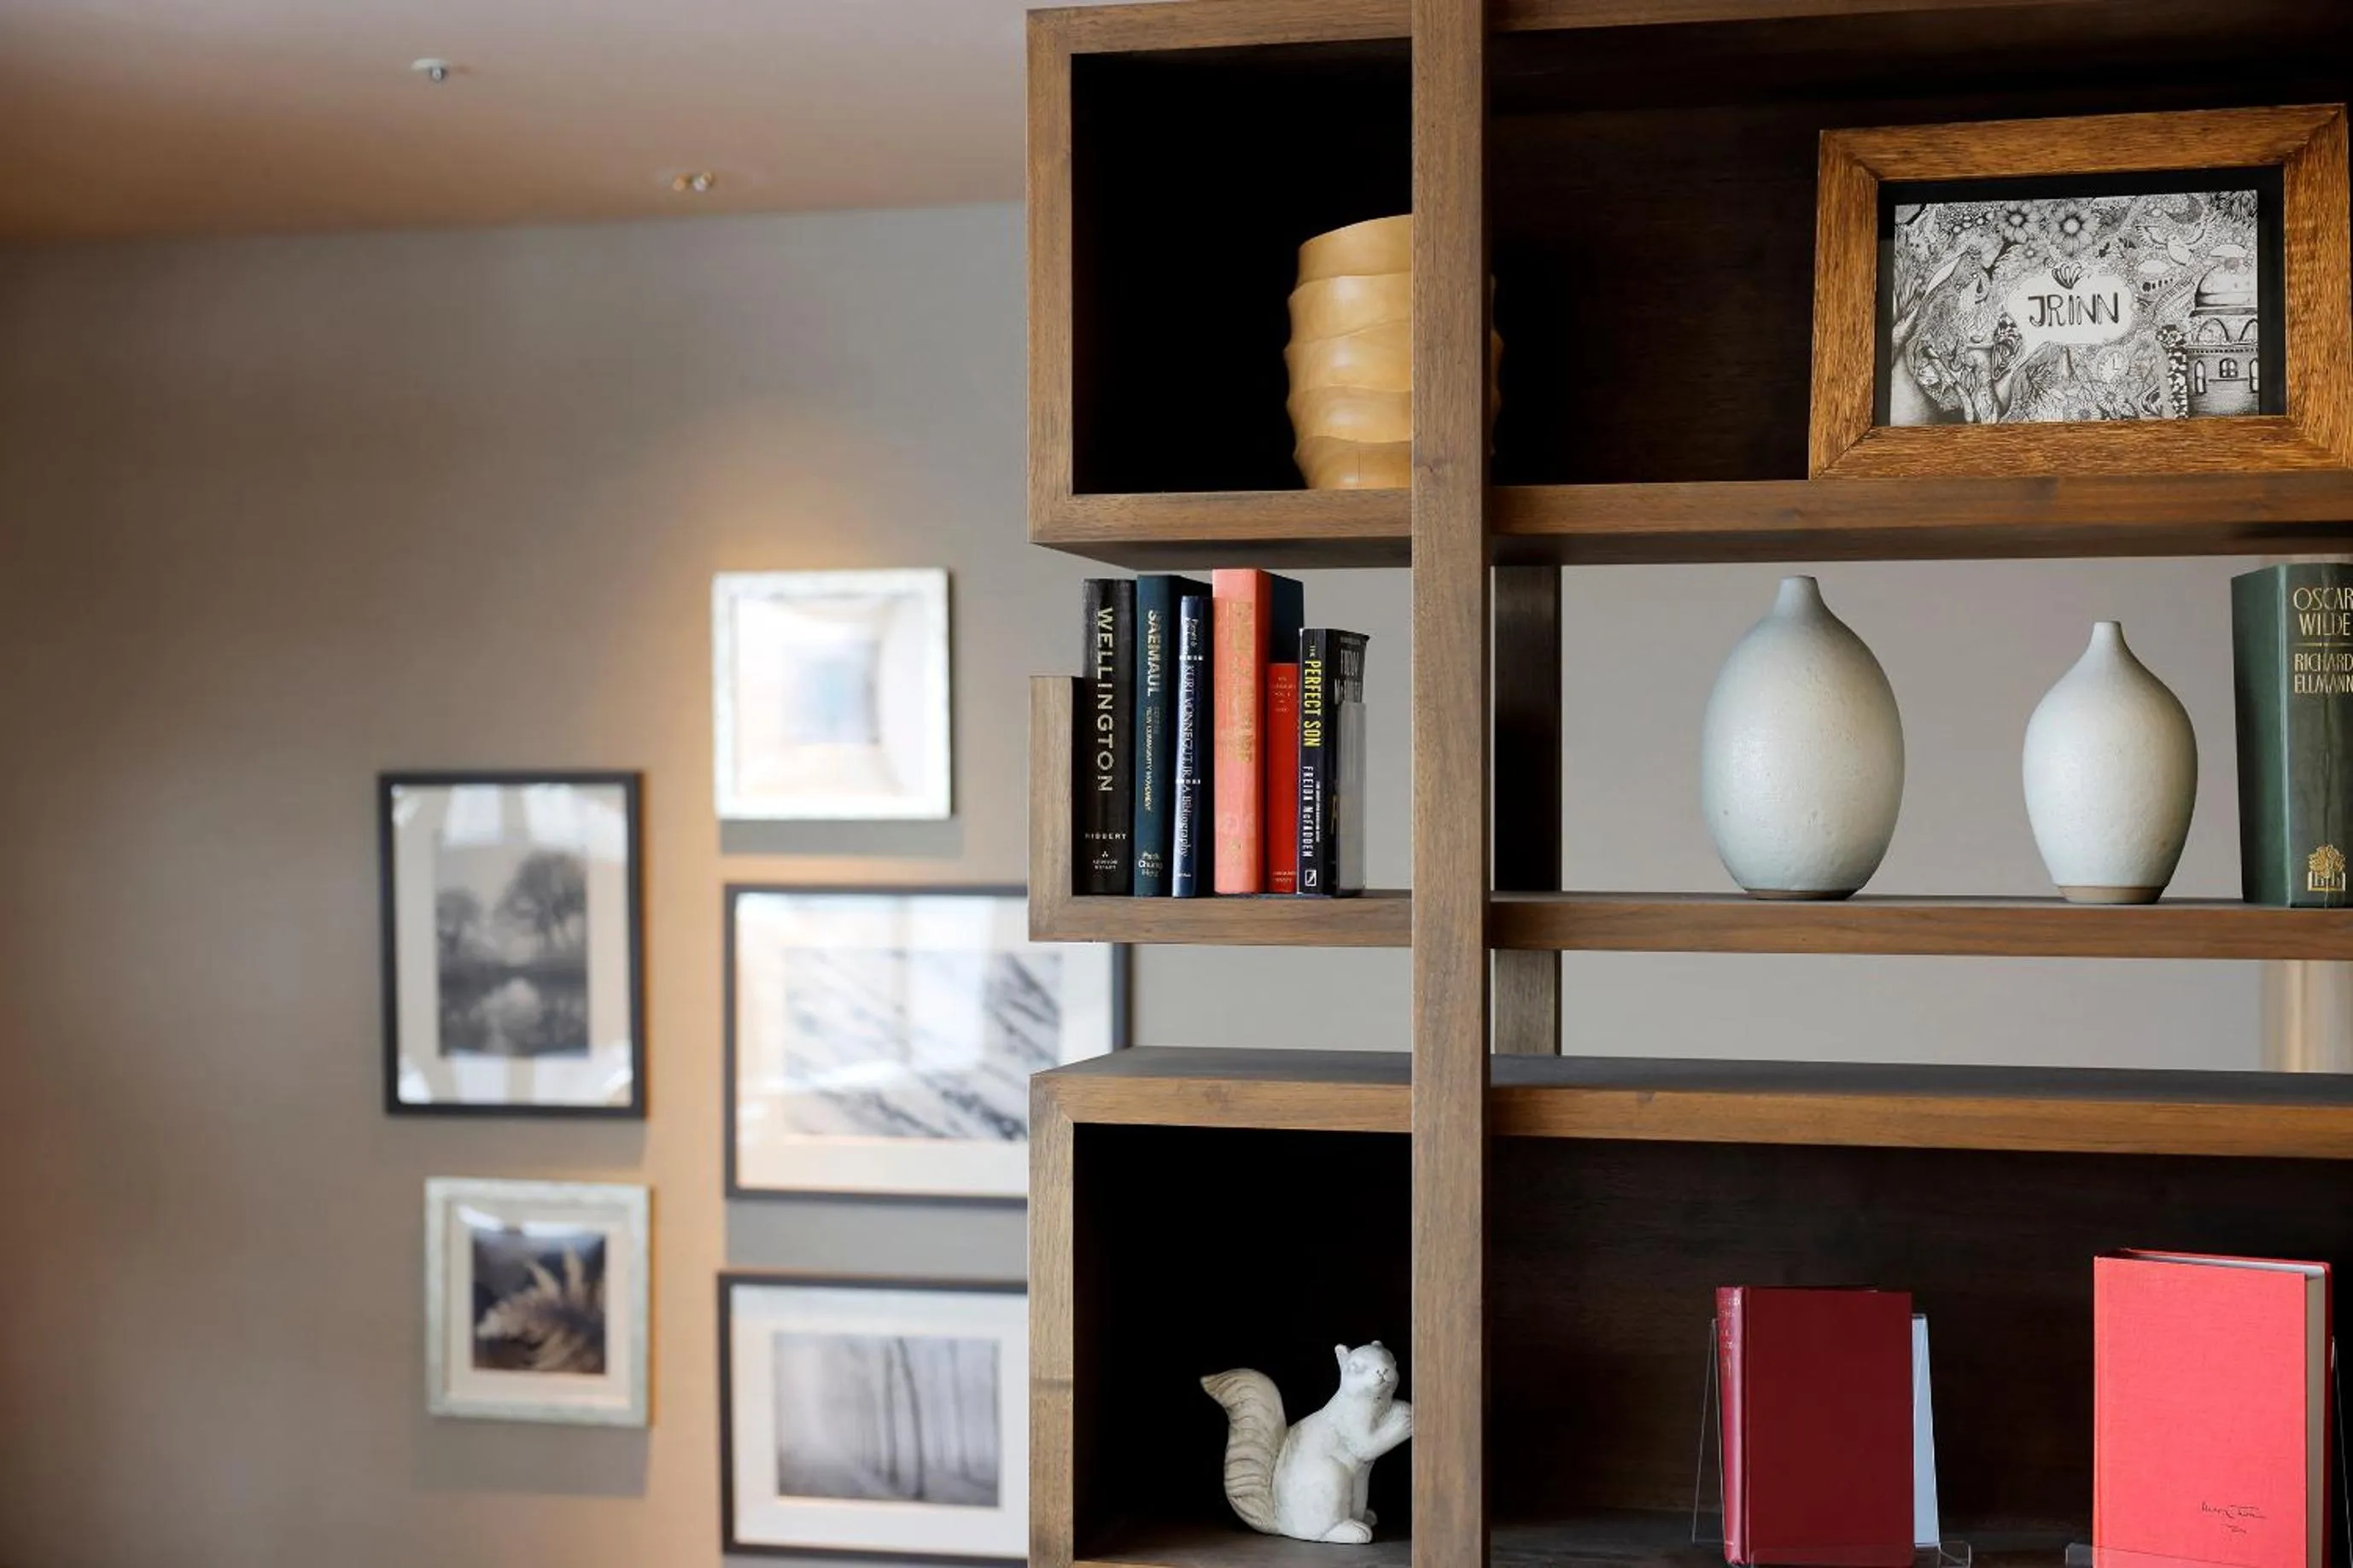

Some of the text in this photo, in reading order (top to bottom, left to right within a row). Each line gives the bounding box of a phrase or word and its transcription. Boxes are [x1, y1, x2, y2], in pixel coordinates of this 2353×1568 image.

[2028, 291, 2120, 327] JRINN
[2293, 586, 2353, 611] OSCAR
[2298, 612, 2350, 636] WILDE
[1147, 609, 1160, 697] SAEMAUL
[2294, 652, 2353, 672] RICHARD
[1097, 607, 1114, 791] WELLINGTON
[1305, 660, 1322, 716] PERFECT
[2294, 673, 2353, 694] ELLMANN
[1304, 720, 1322, 748] SON
[1303, 767, 1314, 801] FREIDA
